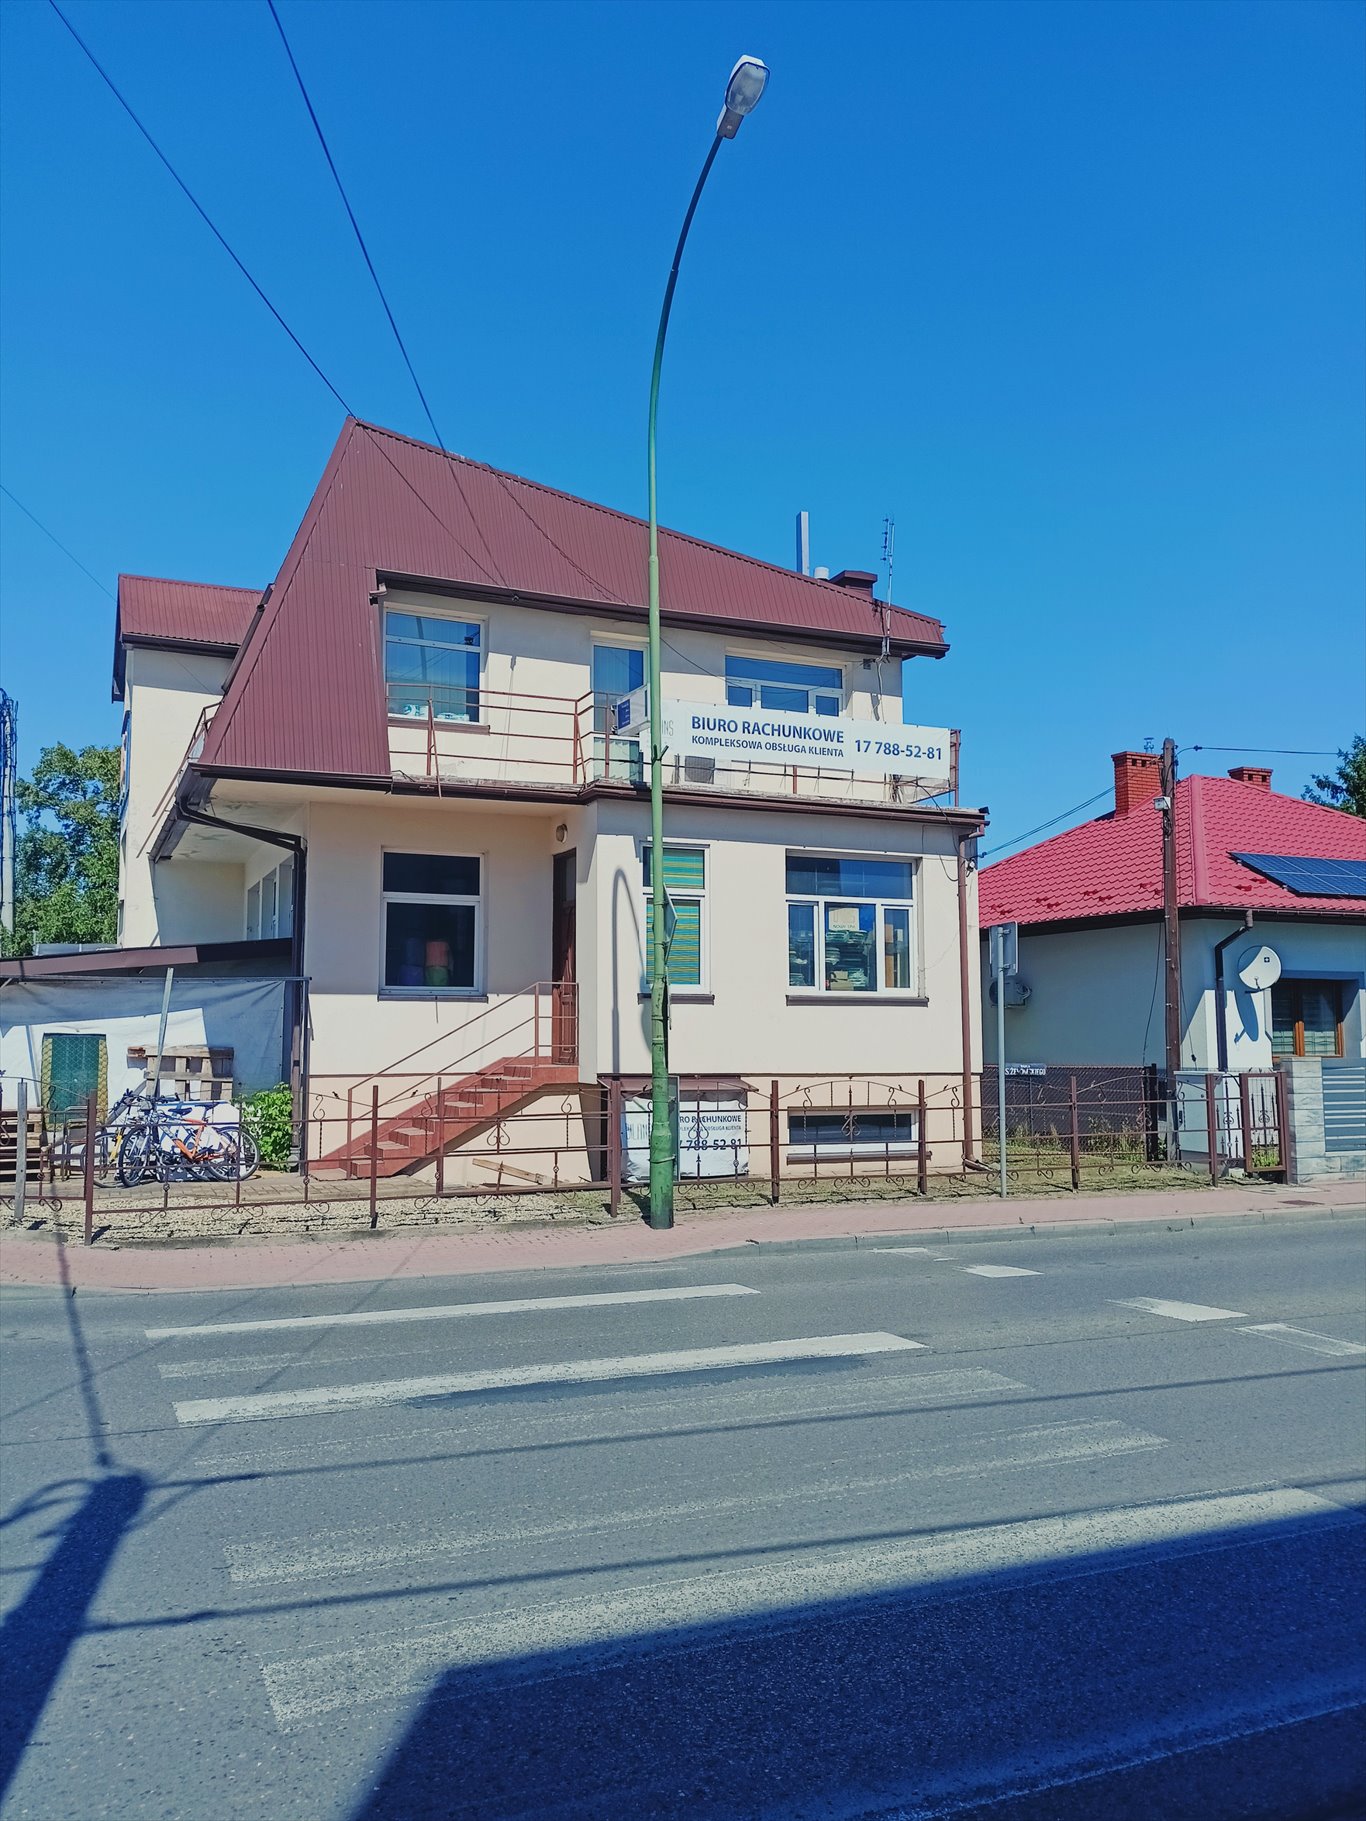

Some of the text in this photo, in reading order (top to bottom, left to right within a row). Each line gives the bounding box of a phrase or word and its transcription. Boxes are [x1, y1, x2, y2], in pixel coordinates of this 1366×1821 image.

[691, 716, 738, 733] BIURO
[742, 720, 844, 743] RACHUNKOWE
[691, 735, 844, 758] KOMPLEKSOWA OBSŁUGA KLIENTA
[854, 739, 942, 760] 17 788-52-81
